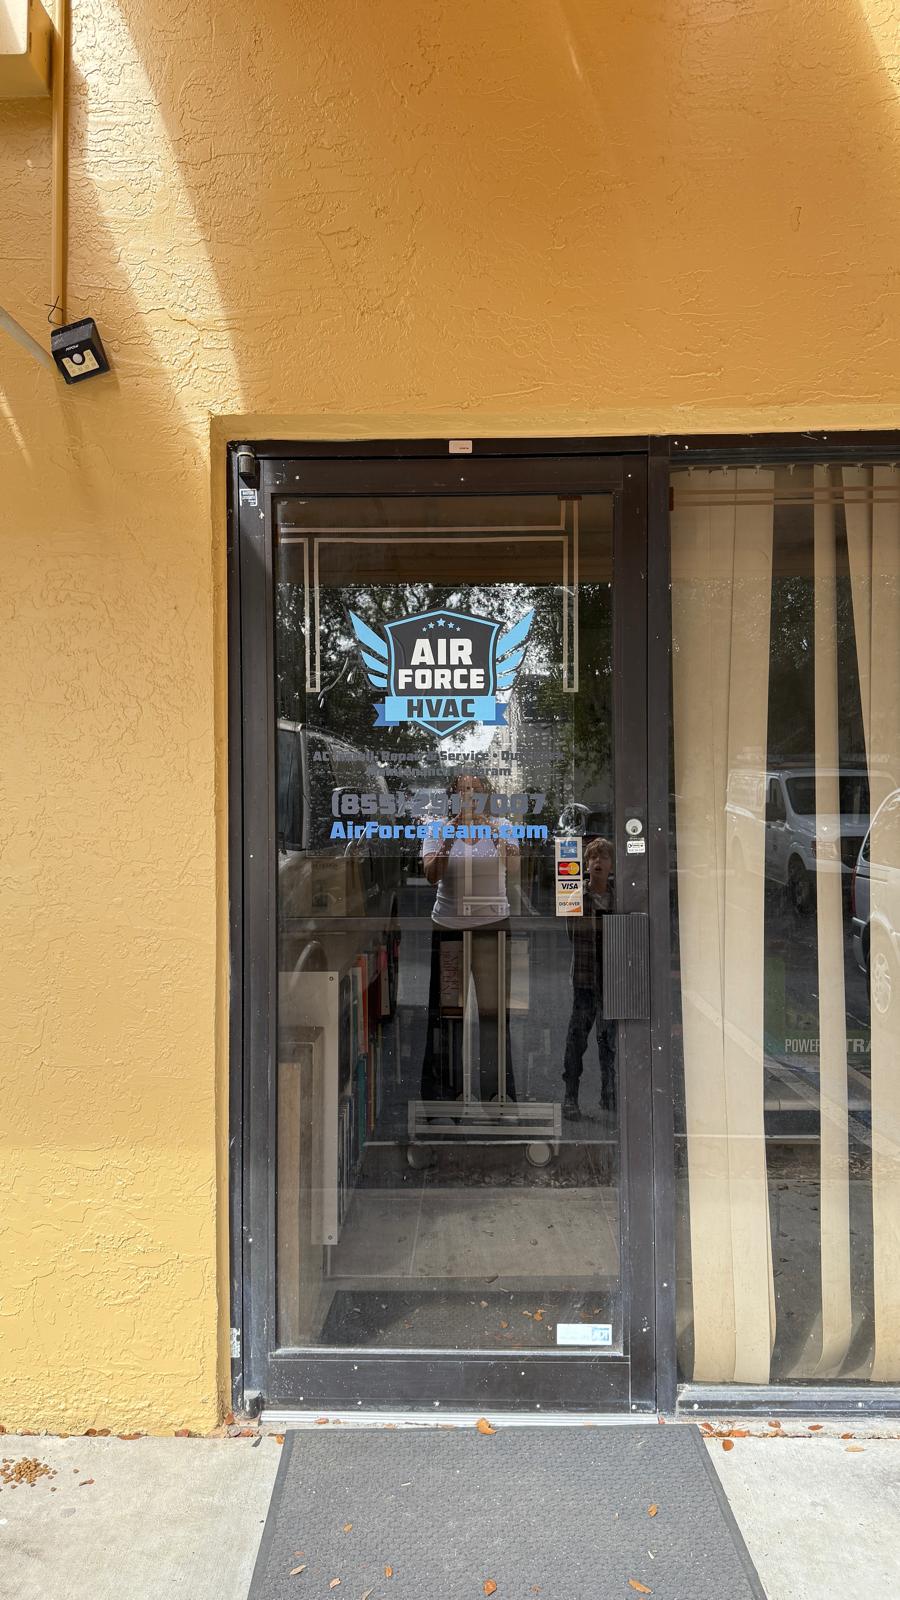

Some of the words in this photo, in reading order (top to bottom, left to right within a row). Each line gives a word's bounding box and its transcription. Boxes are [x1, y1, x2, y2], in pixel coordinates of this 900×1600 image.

[410, 638, 473, 666] AIR
[398, 668, 485, 690] FORCE
[406, 698, 476, 718] HVAC
[313, 751, 330, 762] AC
[440, 750, 489, 761] Service
[331, 790, 406, 818] (855)
[329, 821, 548, 839] AirForceTeam.com
